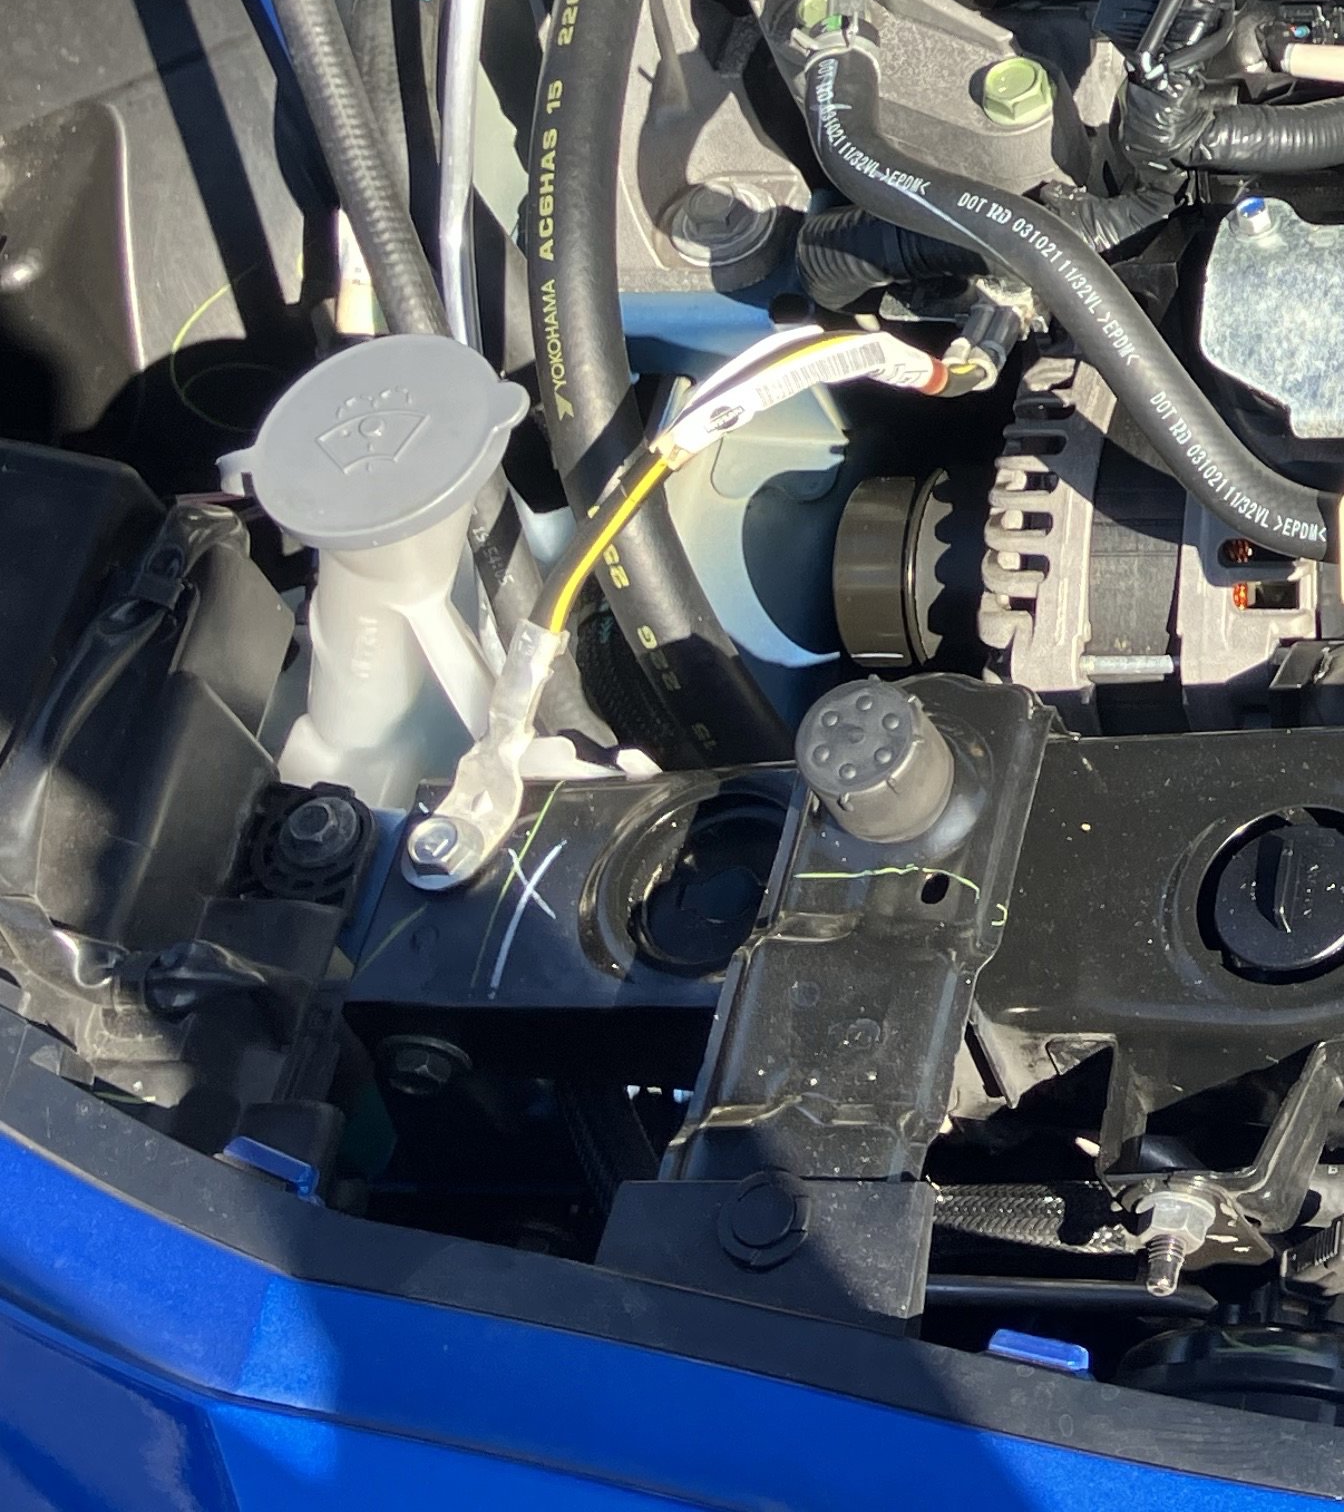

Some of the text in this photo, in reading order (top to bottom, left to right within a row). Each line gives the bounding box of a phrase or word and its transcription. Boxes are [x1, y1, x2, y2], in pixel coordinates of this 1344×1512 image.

[546, 80, 563, 114] 15
[957, 192, 988, 214] DOT
[1012, 218, 1063, 263] 031021
[1058, 260, 1103, 315] 11/32VL
[541, 279, 567, 392] YOKOHAMA
[1150, 391, 1178, 420] DOT
[1186, 444, 1229, 493] 031021
[1223, 486, 1269, 528] 11/32VL
